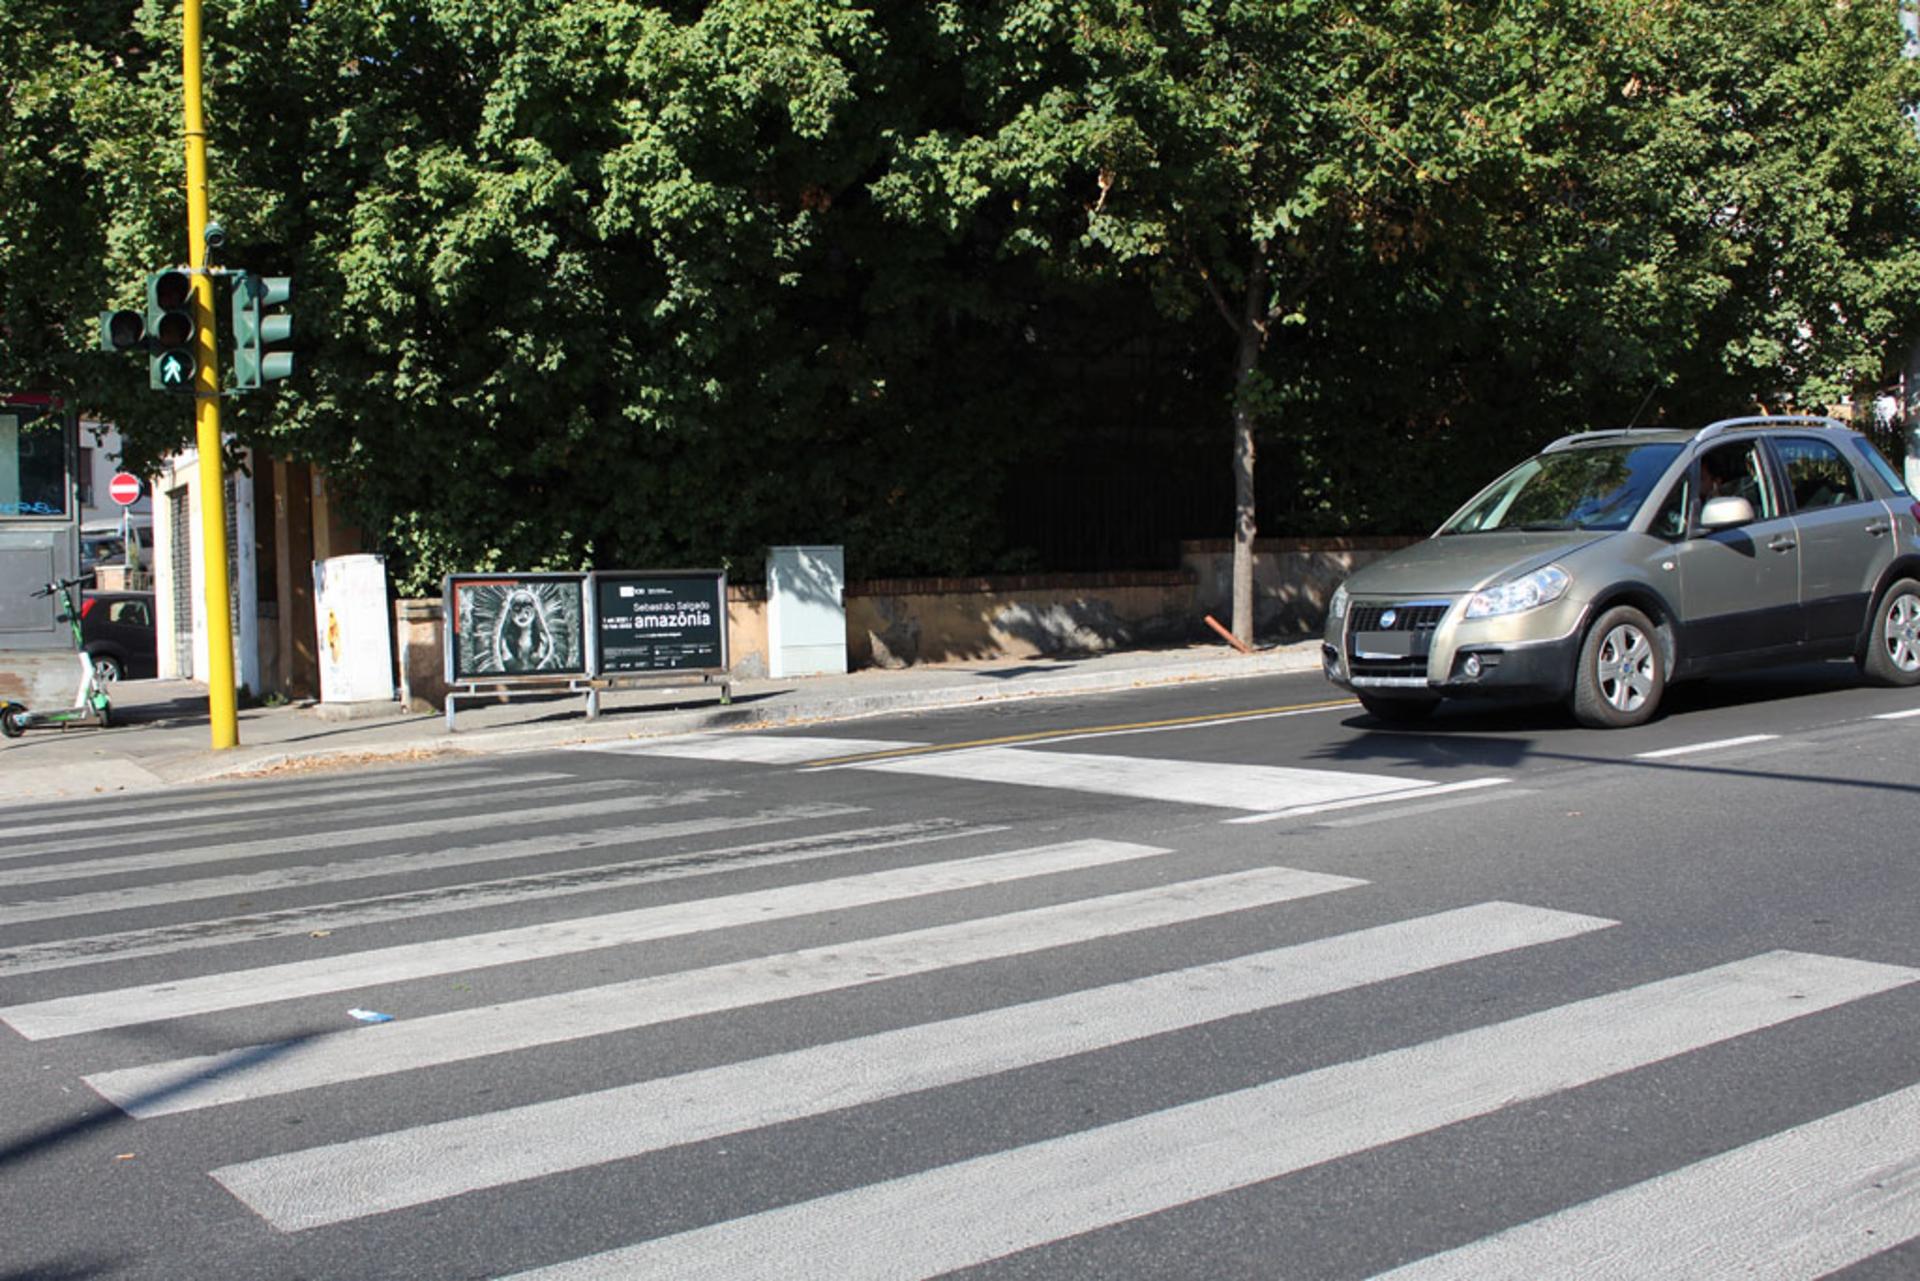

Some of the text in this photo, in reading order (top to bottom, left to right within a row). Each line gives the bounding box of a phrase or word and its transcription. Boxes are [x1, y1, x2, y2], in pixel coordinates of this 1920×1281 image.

[633, 601, 710, 612] Sebastião Salgado
[634, 611, 711, 629] amazônia
